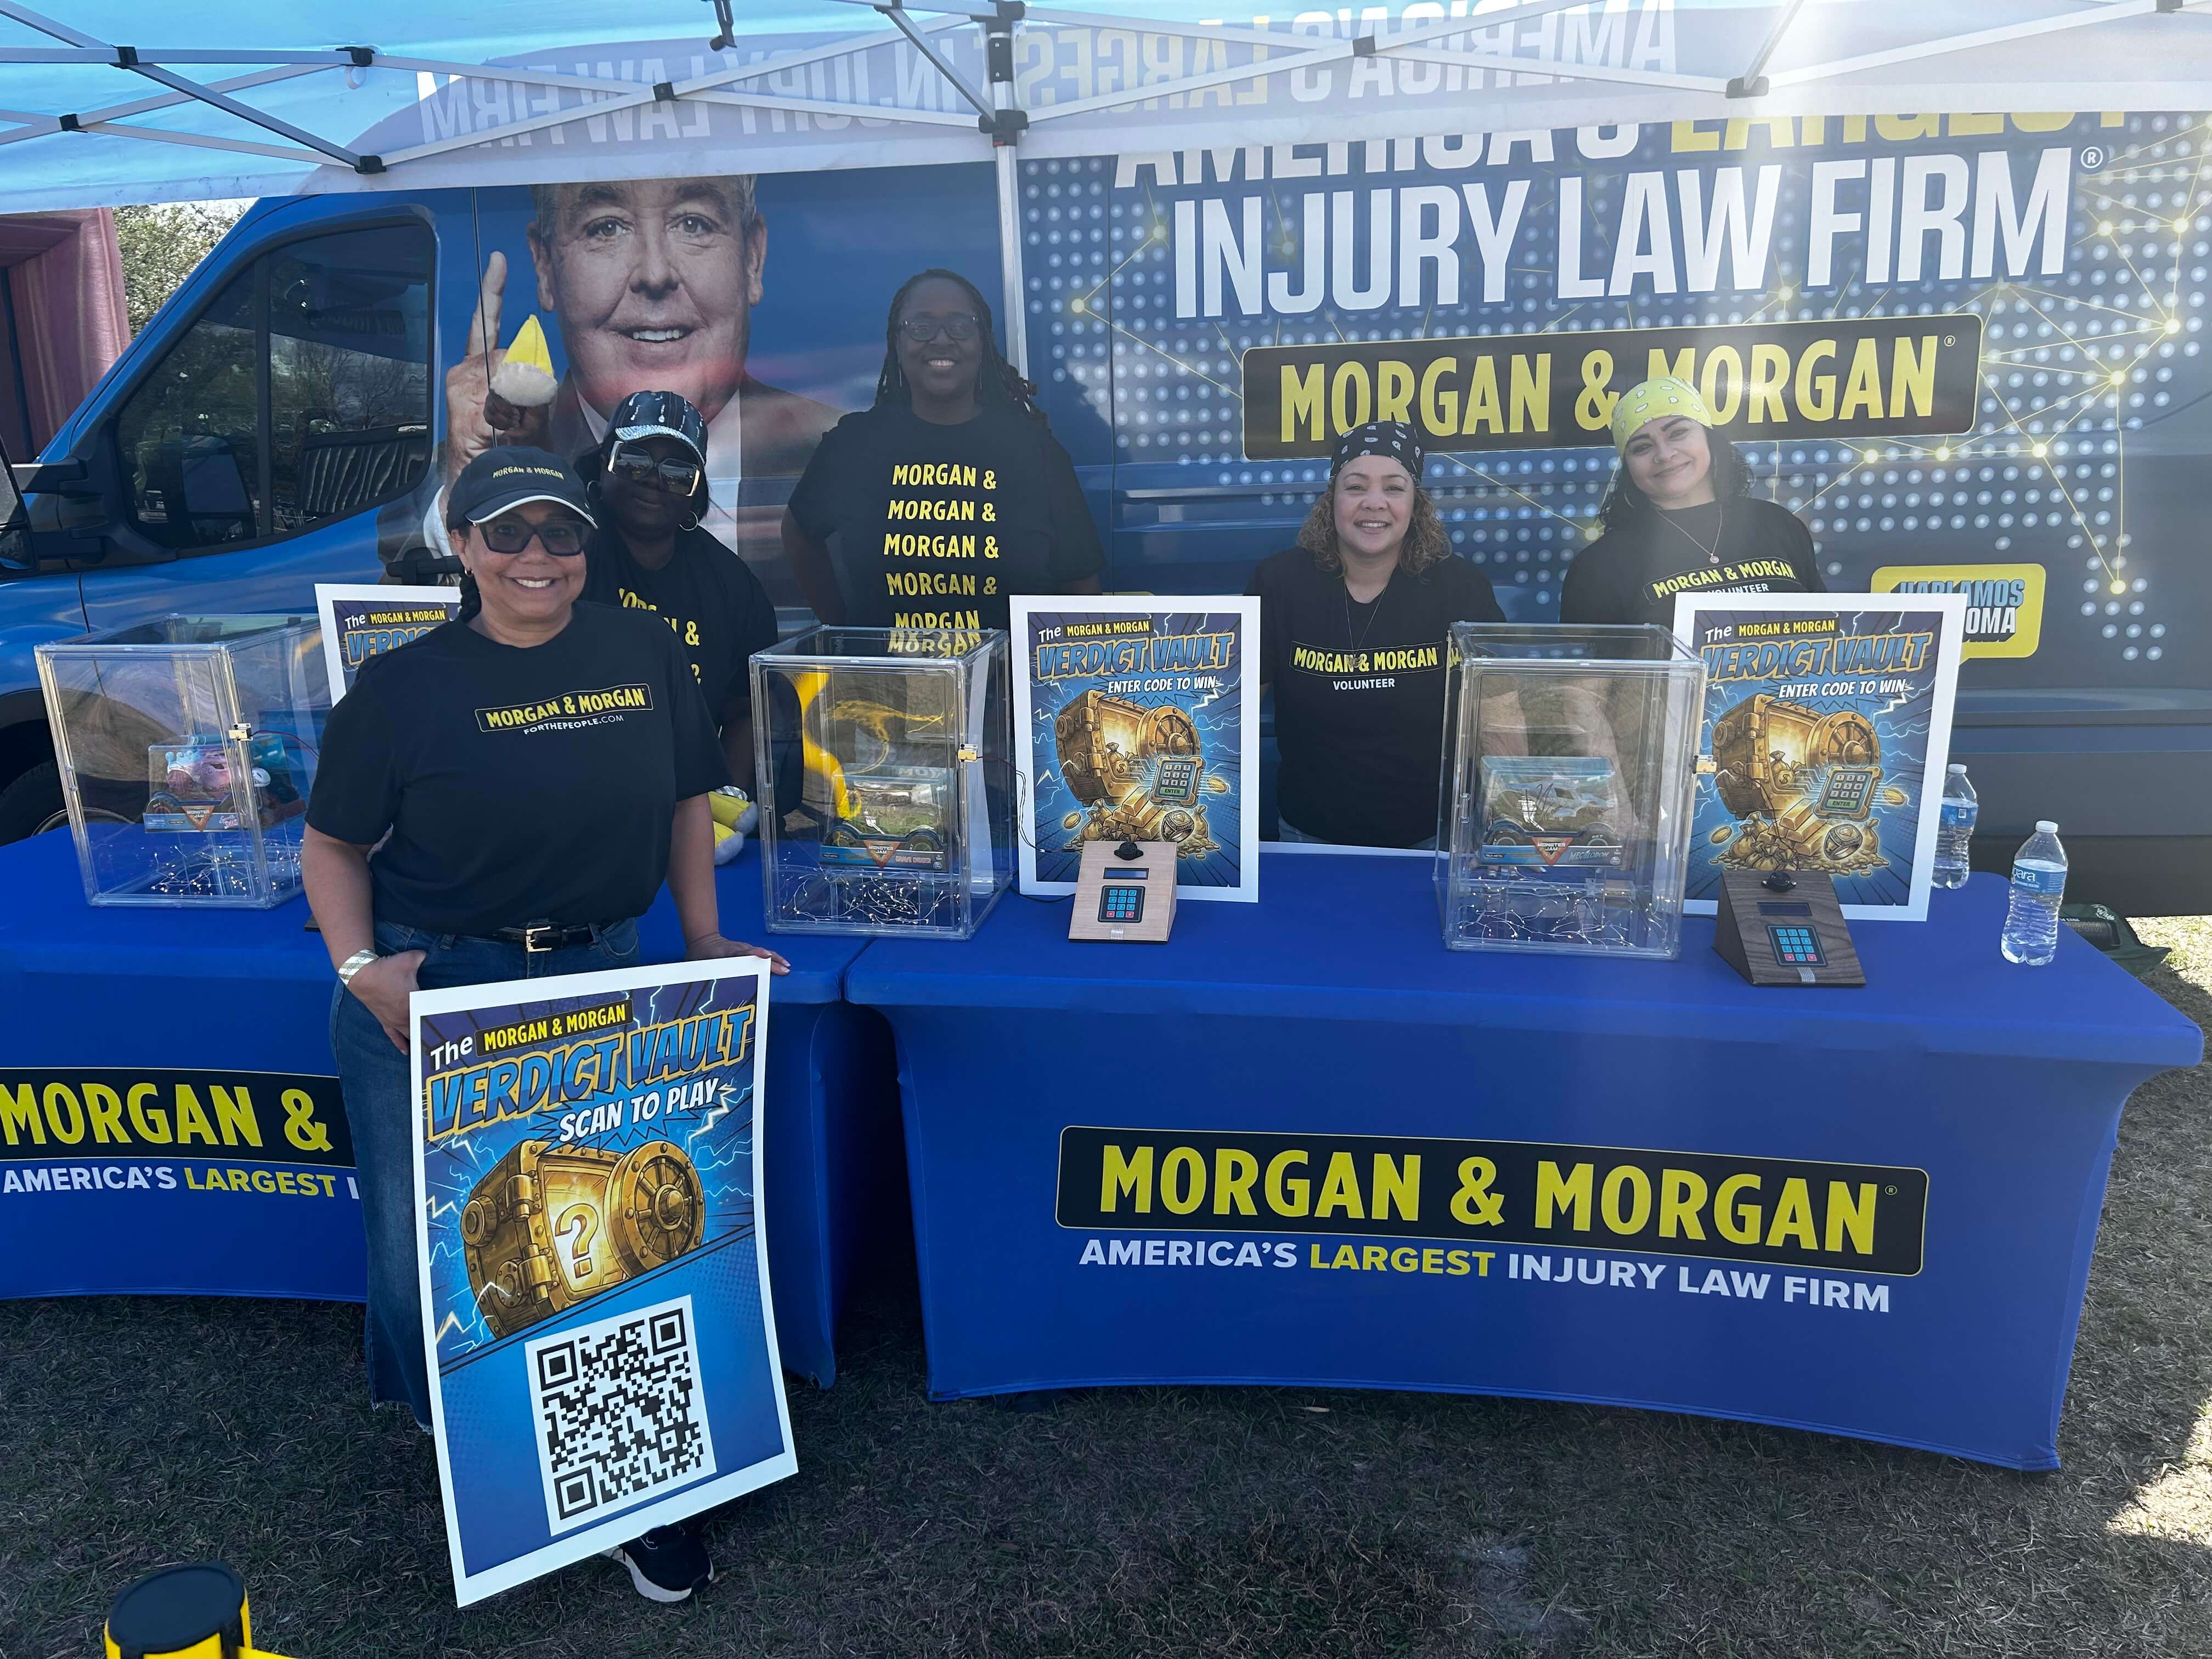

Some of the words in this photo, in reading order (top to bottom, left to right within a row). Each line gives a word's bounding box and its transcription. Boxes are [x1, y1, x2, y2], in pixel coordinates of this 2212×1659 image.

[1175, 180, 1531, 318] INJURY
[1558, 165, 1782, 298] LAW
[1280, 353, 1551, 442] MORGAN
[1575, 349, 1620, 431] &
[493, 466, 524, 479] MORGAN
[534, 467, 565, 481] MORGAN
[892, 463, 976, 488] MORGAN
[983, 470, 997, 489] &
[887, 500, 975, 521] MORGAN
[982, 503, 996, 522] &
[883, 533, 975, 558] MORGAN
[984, 535, 1000, 558] &
[886, 572, 975, 596] MORGAN
[983, 576, 997, 595] &
[1652, 568, 1724, 599] MORGAN
[1724, 567, 1739, 580] &
[1738, 560, 1797, 579] MORGAN
[1707, 583, 1769, 593] UNTEER
[345, 614, 366, 630] The
[370, 612, 403, 624] MORGAN
[405, 612, 411, 622] &
[413, 610, 445, 622] MORGAN
[685, 620, 700, 646] &
[1039, 625, 1062, 642] The
[1066, 624, 1103, 637] MORGAN
[1105, 623, 1111, 634] &
[1113, 620, 1150, 633] MORGAN
[1705, 624, 1732, 644] The
[1738, 623, 1781, 636] MORGAN
[1784, 622, 1791, 634] &
[1793, 619, 1835, 633] MORGAN
[1037, 638, 1149, 679] VERDICT
[1152, 633, 1235, 672] VAULT
[1294, 647, 1355, 673] MORGAN
[1359, 653, 1370, 672] &
[1374, 647, 1438, 671] MORGAN
[1701, 638, 1832, 681] VERDICT
[1834, 632, 1933, 675] VAULT
[1108, 681, 1142, 695] ENTER
[1144, 678, 1173, 692] CODE
[1176, 678, 1190, 690] TO
[1193, 675, 1217, 689] WIN
[1333, 678, 1395, 690] VOLUNTEER
[1779, 684, 1819, 698] ENTER
[1821, 682, 1855, 697] CODE
[1859, 681, 1876, 694] TO
[1879, 679, 1906, 693] WIN
[486, 701, 561, 727] MORGAN
[563, 696, 576, 714] &
[578, 687, 646, 713] MORGAN
[523, 714, 624, 735] FORTHEPEOPLE.COM
[430, 1036, 473, 1071] The
[484, 1019, 548, 1052] MORGAN
[551, 1019, 563, 1036] &
[566, 1004, 627, 1034] MORGAN
[426, 1035, 623, 1141] VERDICT
[628, 1006, 755, 1088] VAULT
[0, 1082, 263, 1147] MORGAN
[280, 1088, 334, 1152] &
[559, 1099, 623, 1142] SCAN
[630, 1093, 661, 1123] TO
[665, 1077, 719, 1115] PLAY
[184, 1167, 337, 1198] LARGEST
[1100, 1144, 1421, 1221] MORGAN
[1450, 1156, 1505, 1226] &
[1310, 1243, 1496, 1277] LARGEST
[1508, 1254, 1667, 1290] INJURY
[1679, 1266, 1771, 1300] LAW
[1784, 1276, 1890, 1313] FIRM
